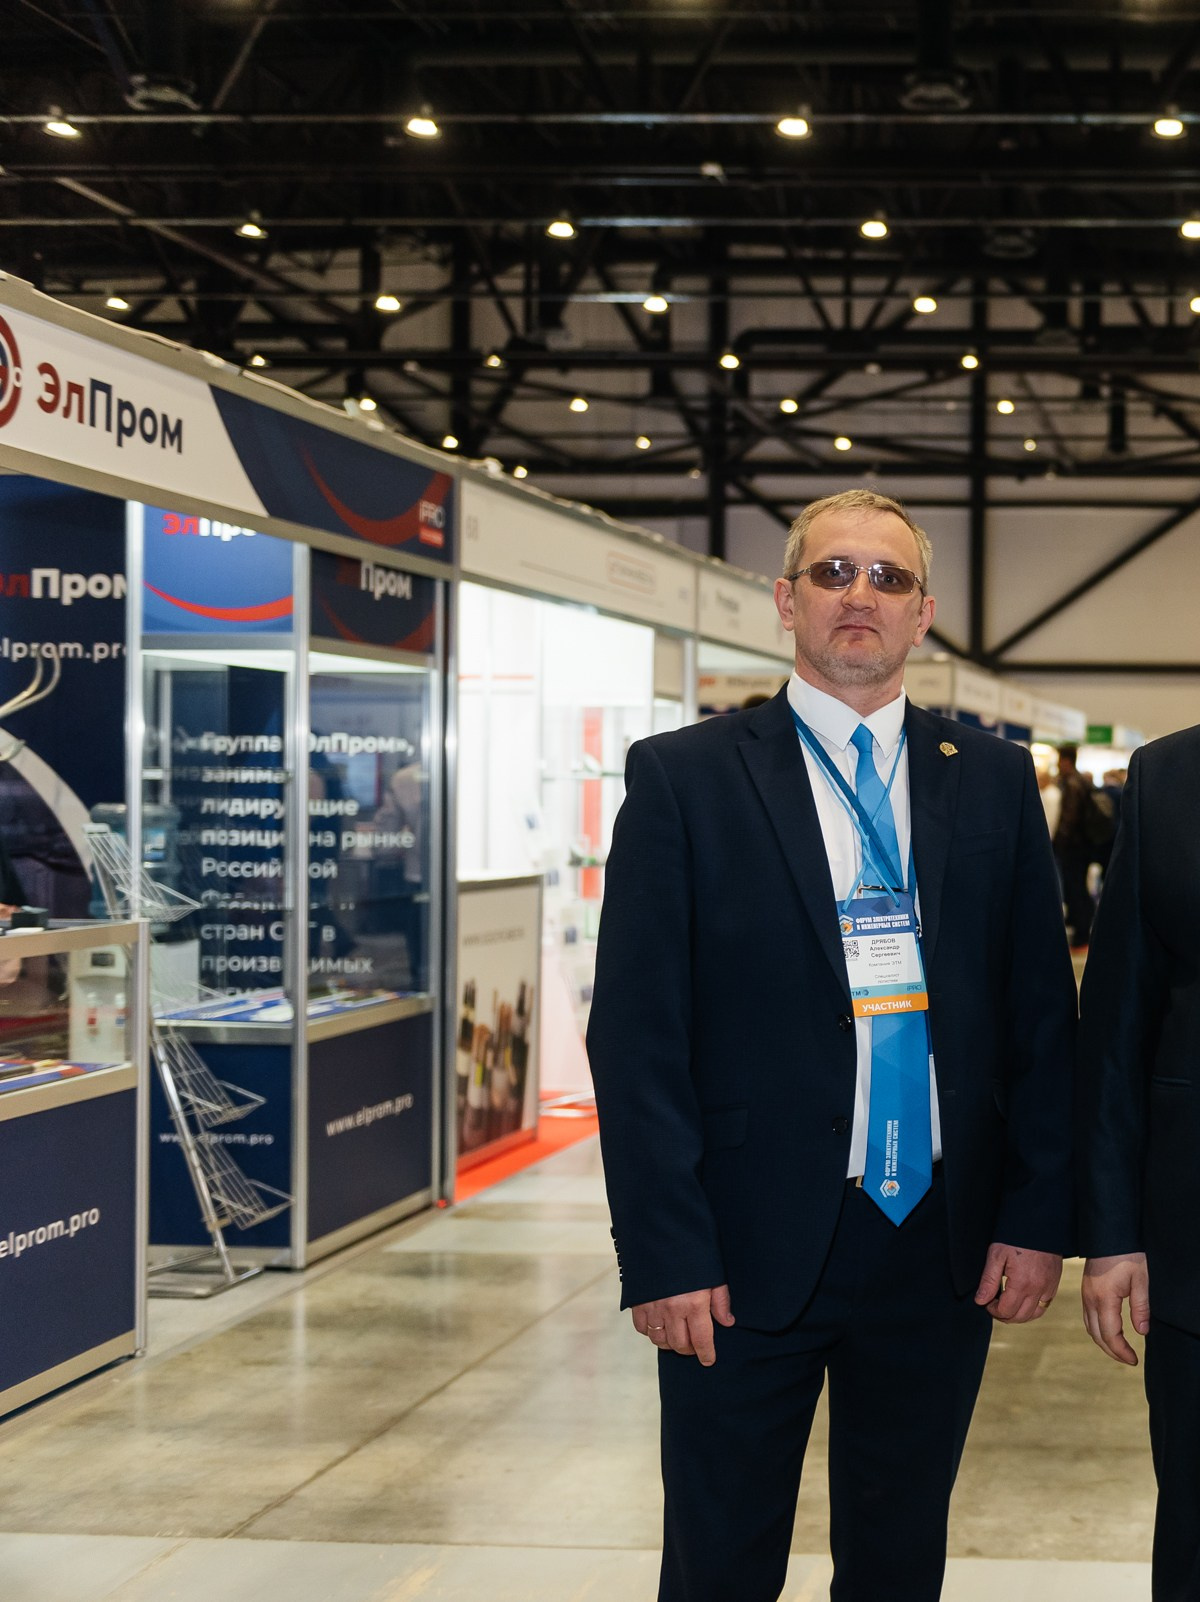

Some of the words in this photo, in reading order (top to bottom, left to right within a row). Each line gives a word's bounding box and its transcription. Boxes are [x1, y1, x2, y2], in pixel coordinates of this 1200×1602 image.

[37, 362, 183, 454] ЭлПром
[0, 637, 127, 663] lprom.pr
[202, 768, 288, 784] занима
[202, 798, 359, 818] лидирущие
[341, 831, 416, 851] рынке
[201, 924, 264, 942] стран
[862, 1000, 912, 1012] УЧАСТНИК
[326, 1093, 413, 1137] www.elprom.pro
